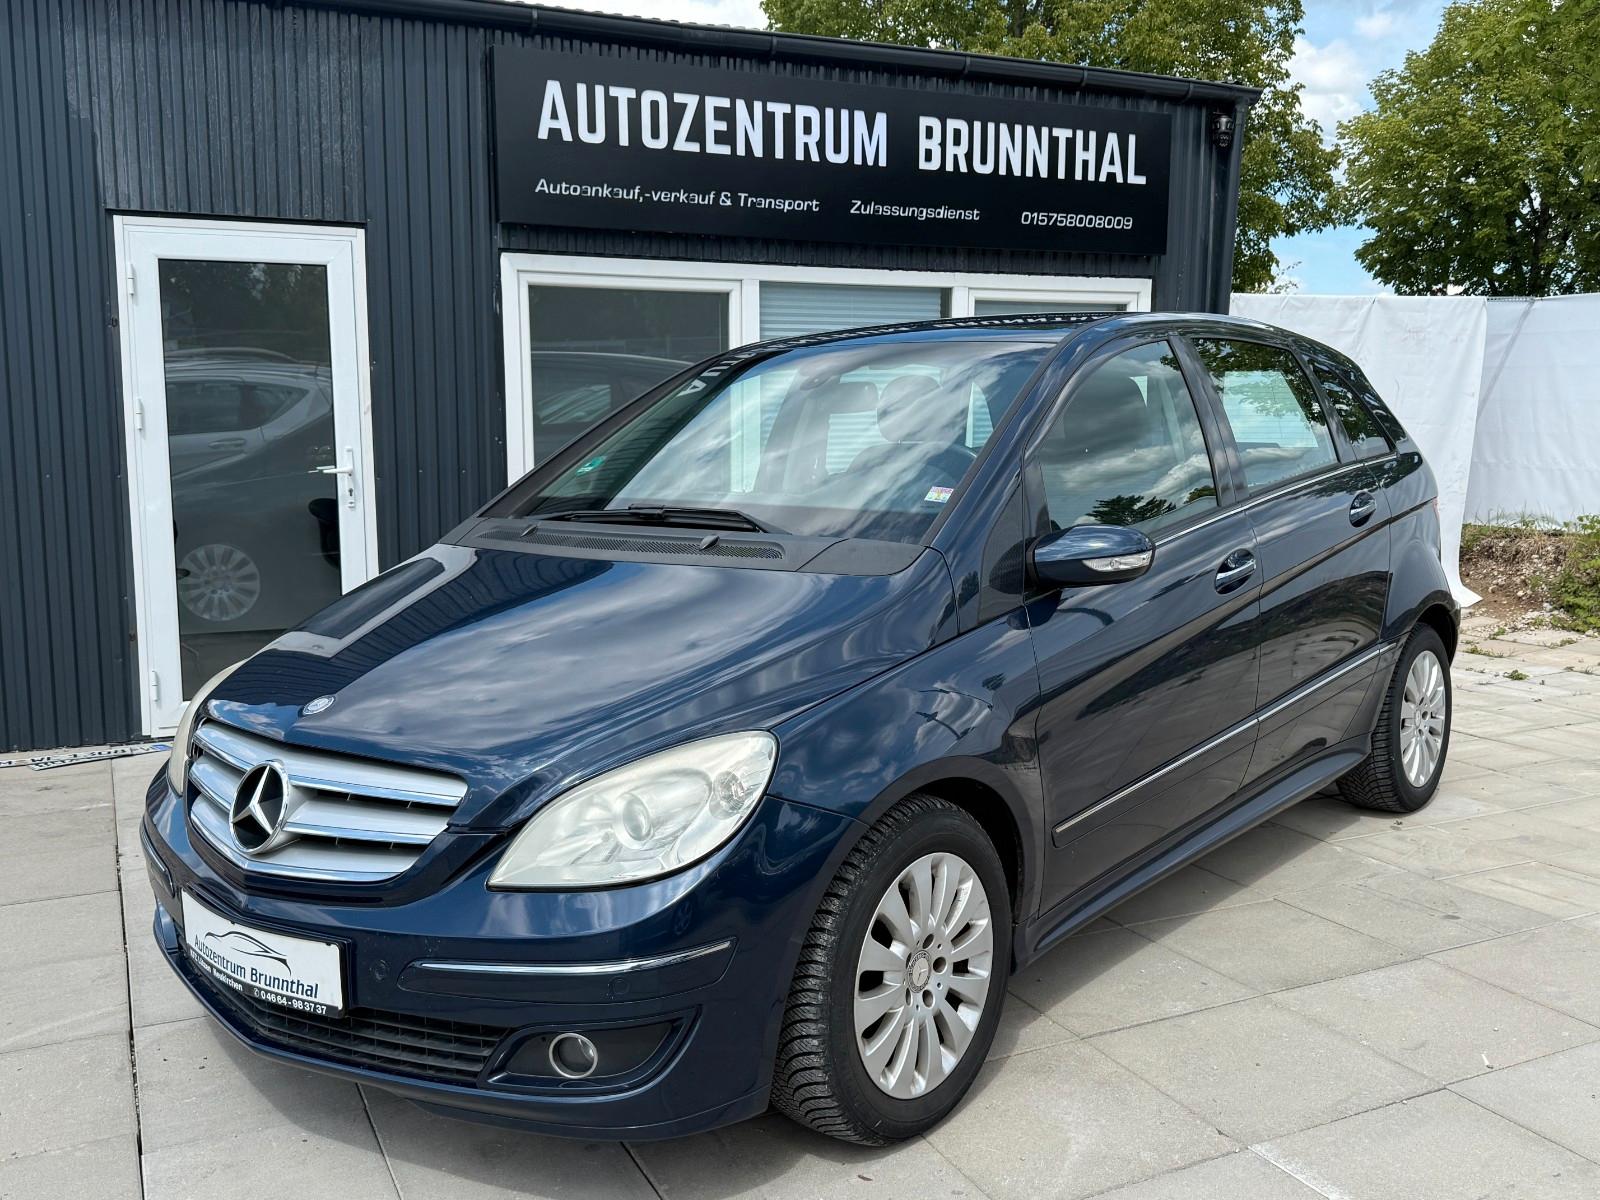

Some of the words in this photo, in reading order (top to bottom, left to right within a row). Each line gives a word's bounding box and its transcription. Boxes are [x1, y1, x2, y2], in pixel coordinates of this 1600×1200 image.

[537, 79, 888, 168] AUTOZENTRUM
[917, 115, 1147, 185] BRUNNTHAL
[534, 178, 716, 206] Autoankauf,-verkauf
[719, 192, 732, 206] &
[738, 193, 820, 213] Transport
[849, 199, 980, 221] Zulassungsdienst
[1020, 211, 1133, 230] 015758008009
[194, 934, 246, 979] Autozentrum
[250, 967, 319, 999] Brunnthal
